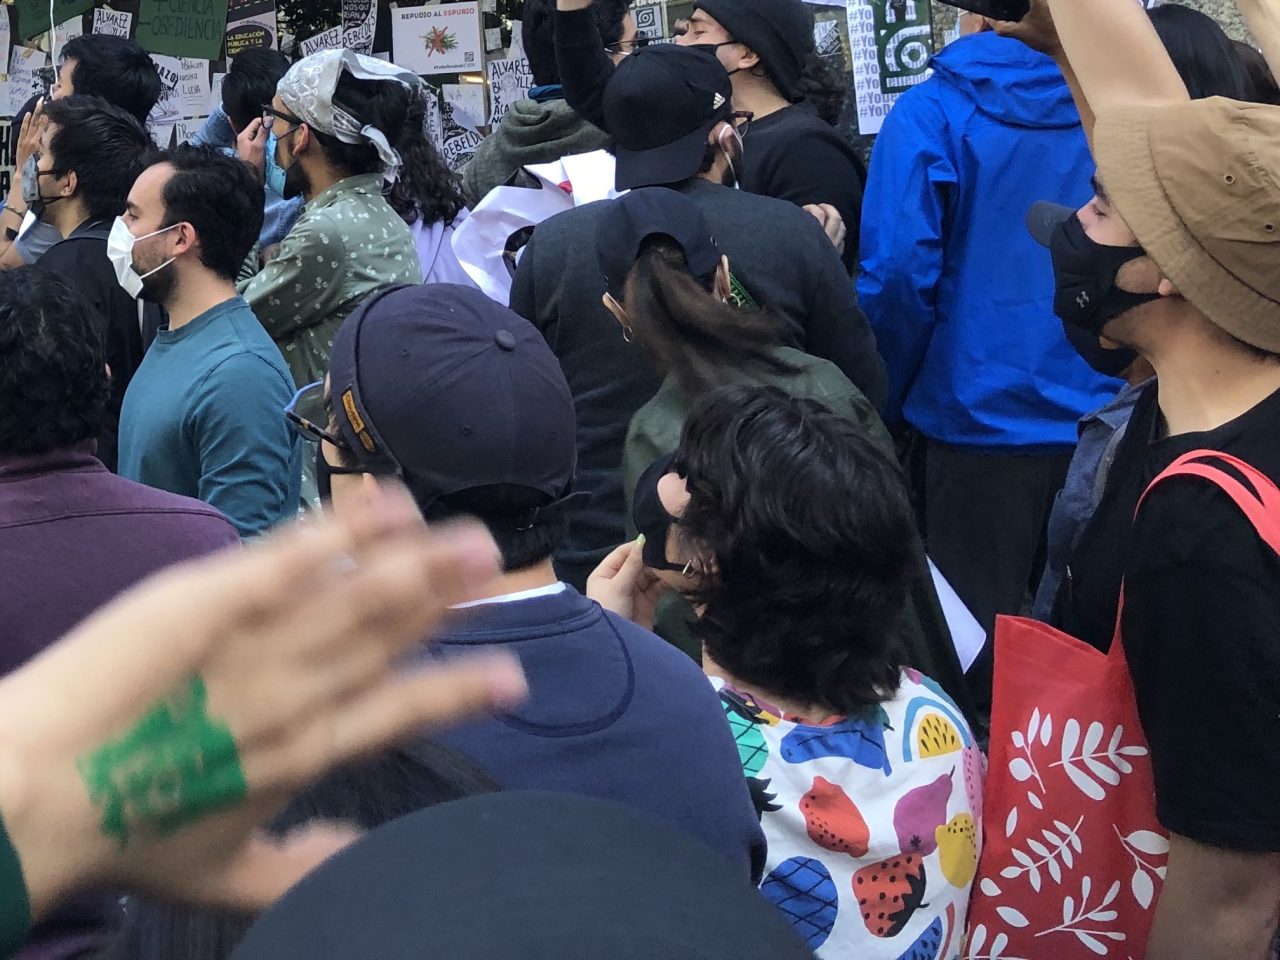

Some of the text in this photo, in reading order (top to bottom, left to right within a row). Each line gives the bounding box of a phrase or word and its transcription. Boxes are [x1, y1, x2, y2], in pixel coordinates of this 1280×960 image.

[95, 7, 129, 29] ALVAREZ
[401, 12, 432, 20] REPUDIO
[443, 7, 475, 17] ESPURIO
